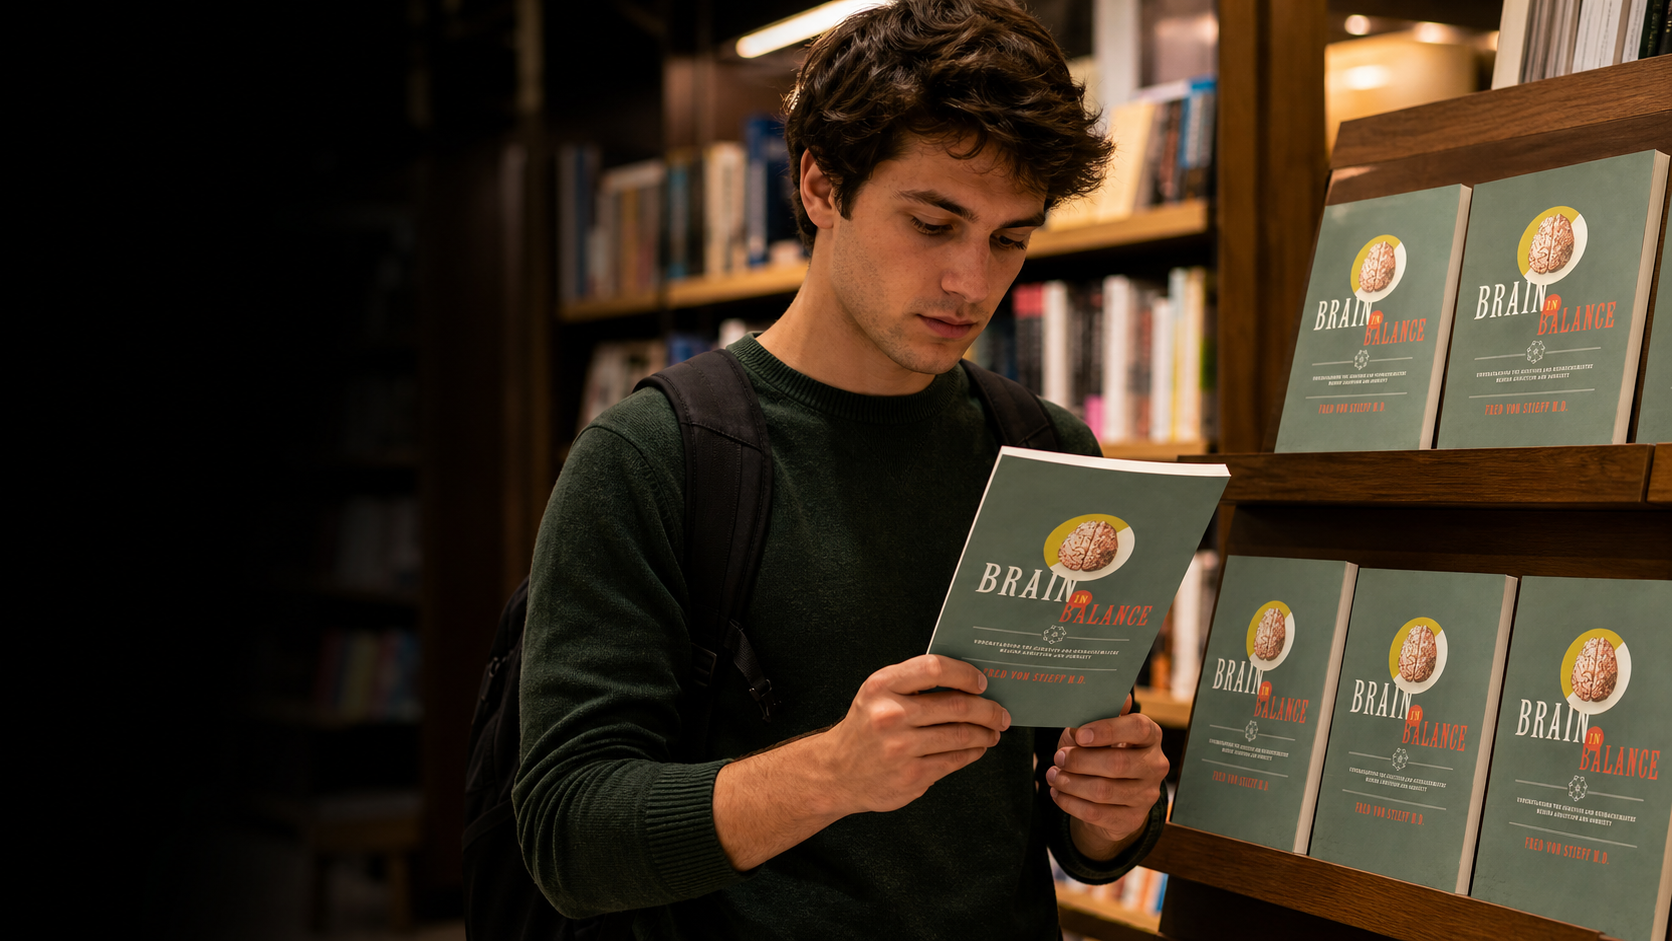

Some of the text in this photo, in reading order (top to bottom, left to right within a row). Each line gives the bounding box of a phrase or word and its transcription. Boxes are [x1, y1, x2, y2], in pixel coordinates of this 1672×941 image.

[1313, 297, 1373, 331] BRAIN
[1474, 280, 1547, 320] BRAIN
[1546, 299, 1558, 311] IN
[1363, 318, 1427, 346] BALANCE
[1537, 301, 1617, 336] BALANCE
[975, 562, 1077, 603] BRAIN
[1073, 594, 1089, 604] IN
[1058, 604, 1153, 627] BALANCE
[1212, 658, 1264, 695] BRAIN
[1253, 696, 1309, 723] BALANCE
[1350, 679, 1413, 720] BRAIN
[1410, 710, 1421, 722] IN
[1401, 720, 1468, 752] BALANCE
[1515, 699, 1590, 744] BRAIN
[1588, 732, 1601, 745] IN
[1579, 745, 1661, 780] BALANCE
